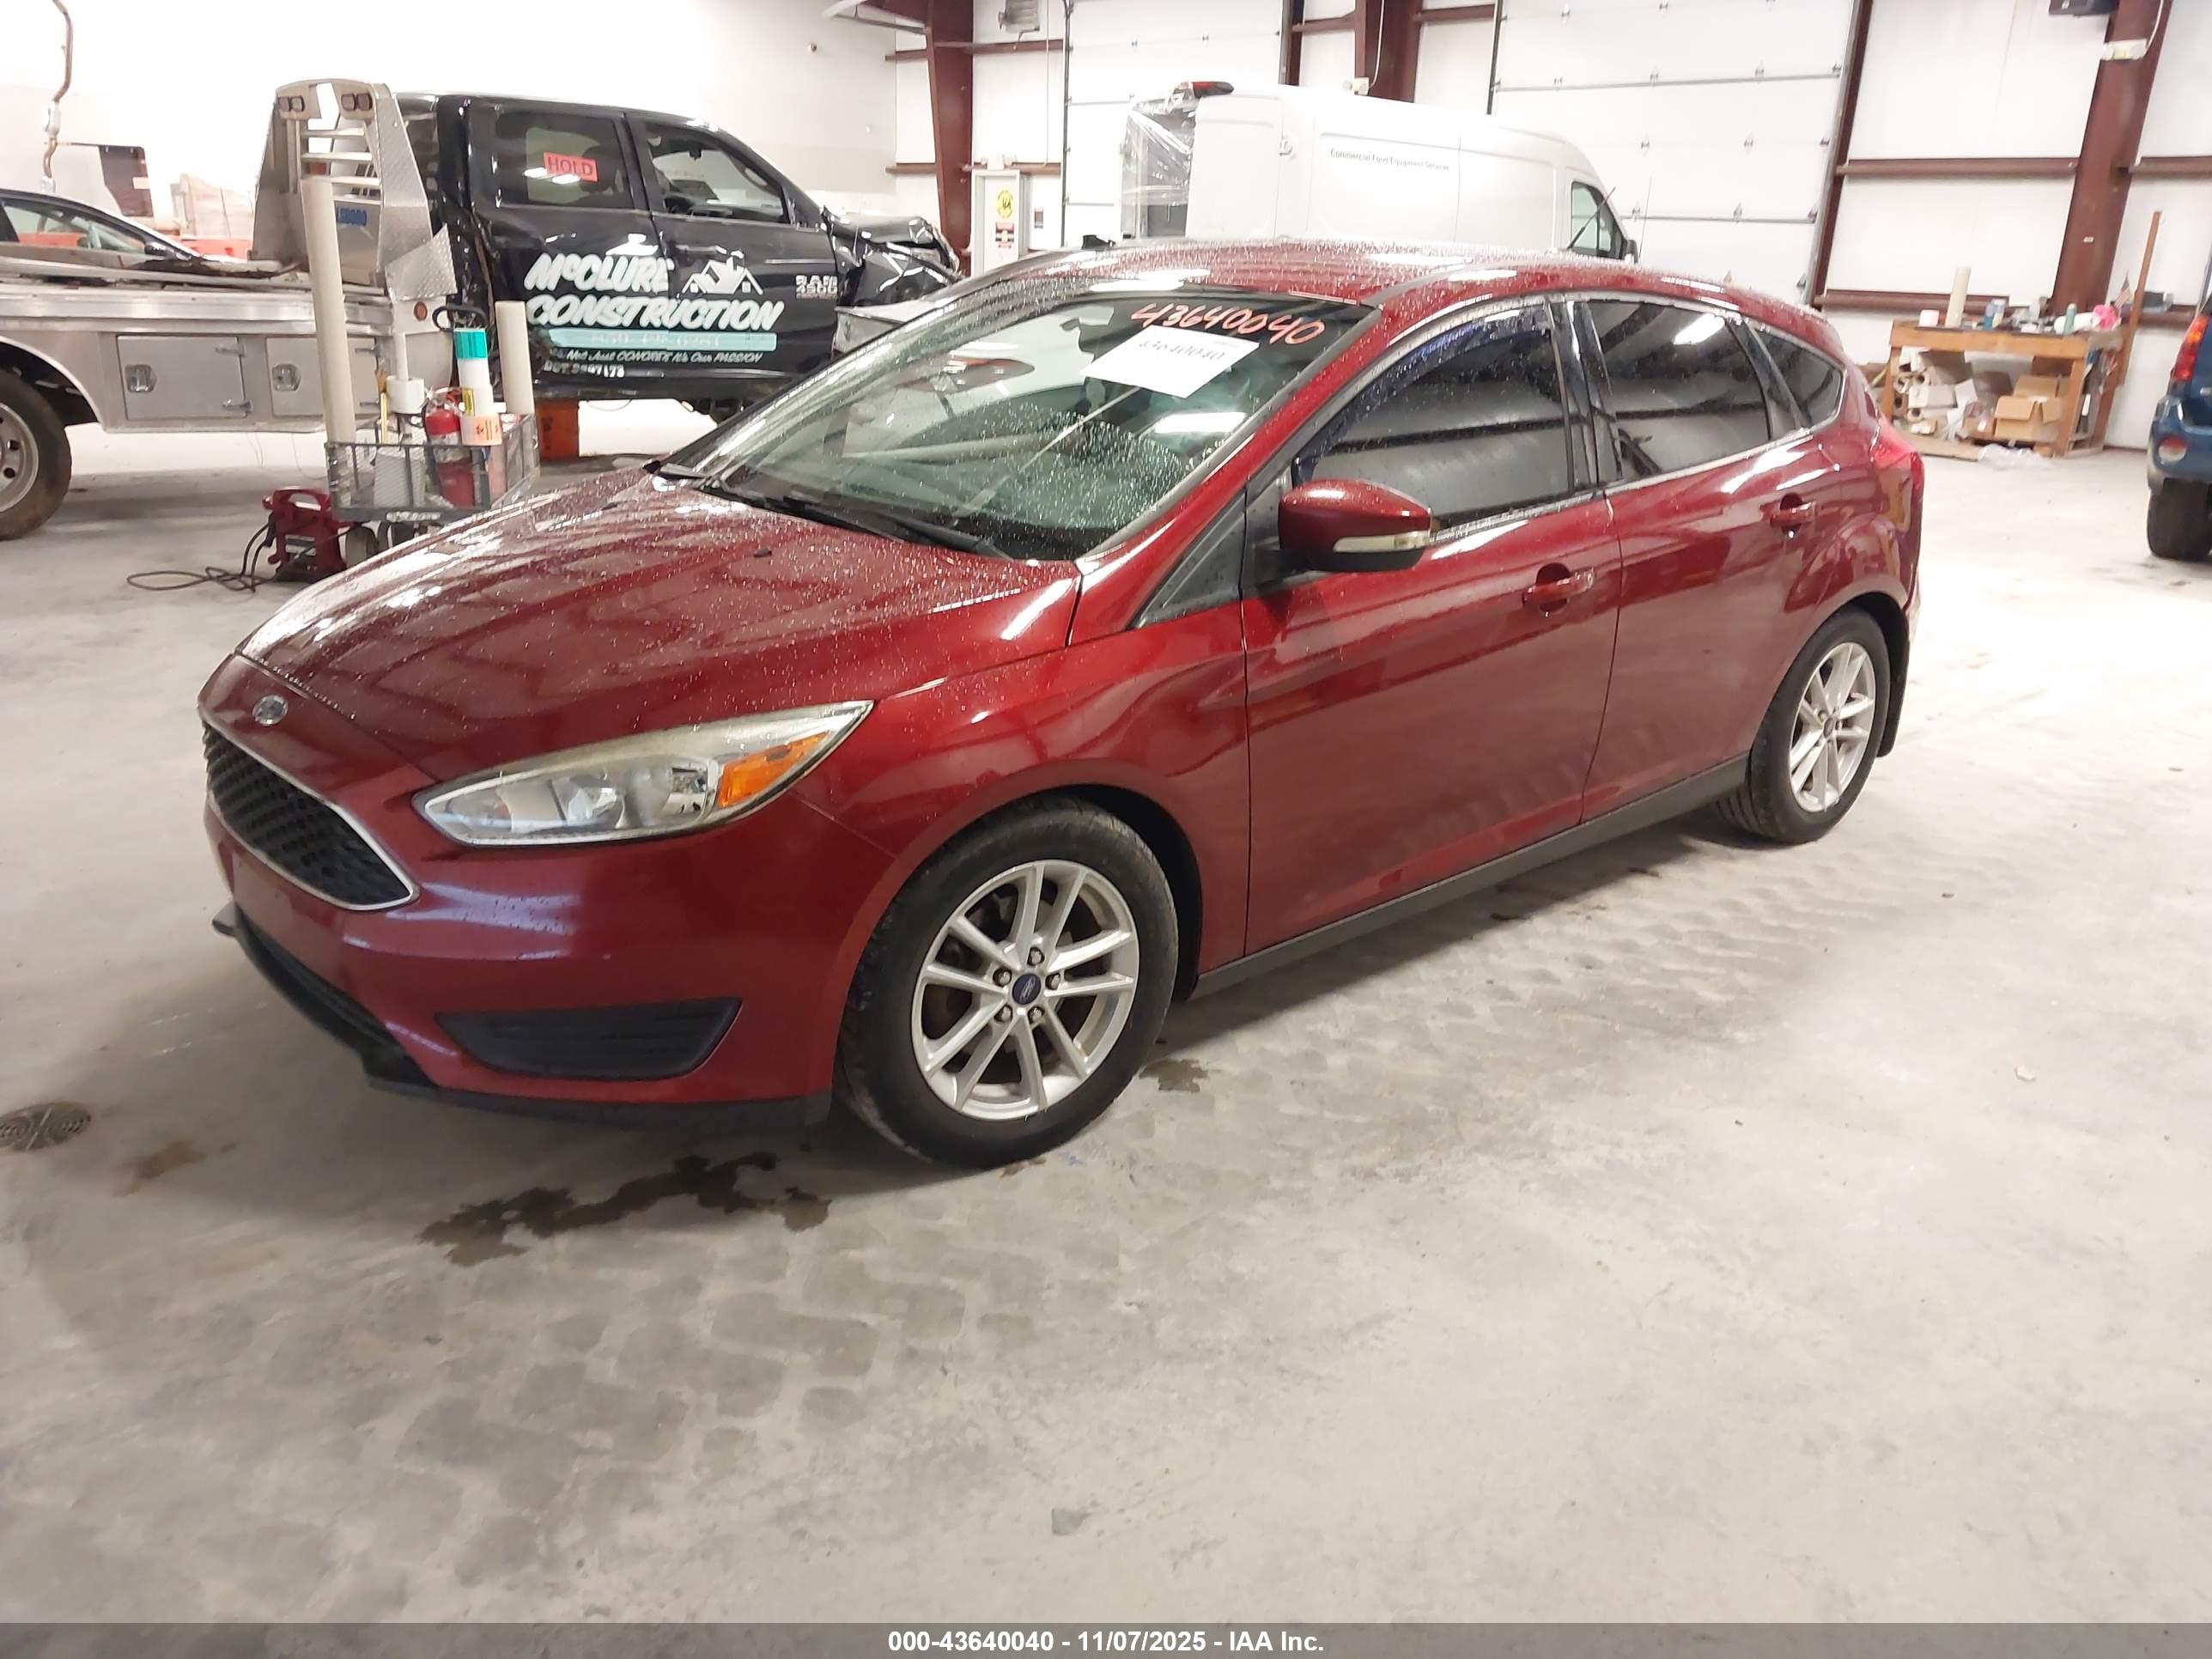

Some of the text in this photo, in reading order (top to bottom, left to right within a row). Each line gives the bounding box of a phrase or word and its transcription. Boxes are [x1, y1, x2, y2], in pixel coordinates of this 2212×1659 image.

[547, 155, 593, 176] HOLD
[1330, 149, 1370, 161] Commercial
[526, 294, 785, 331] CONSTRUCTION
[1130, 302, 1325, 344] 43640040
[713, 351, 763, 363] PASSION
